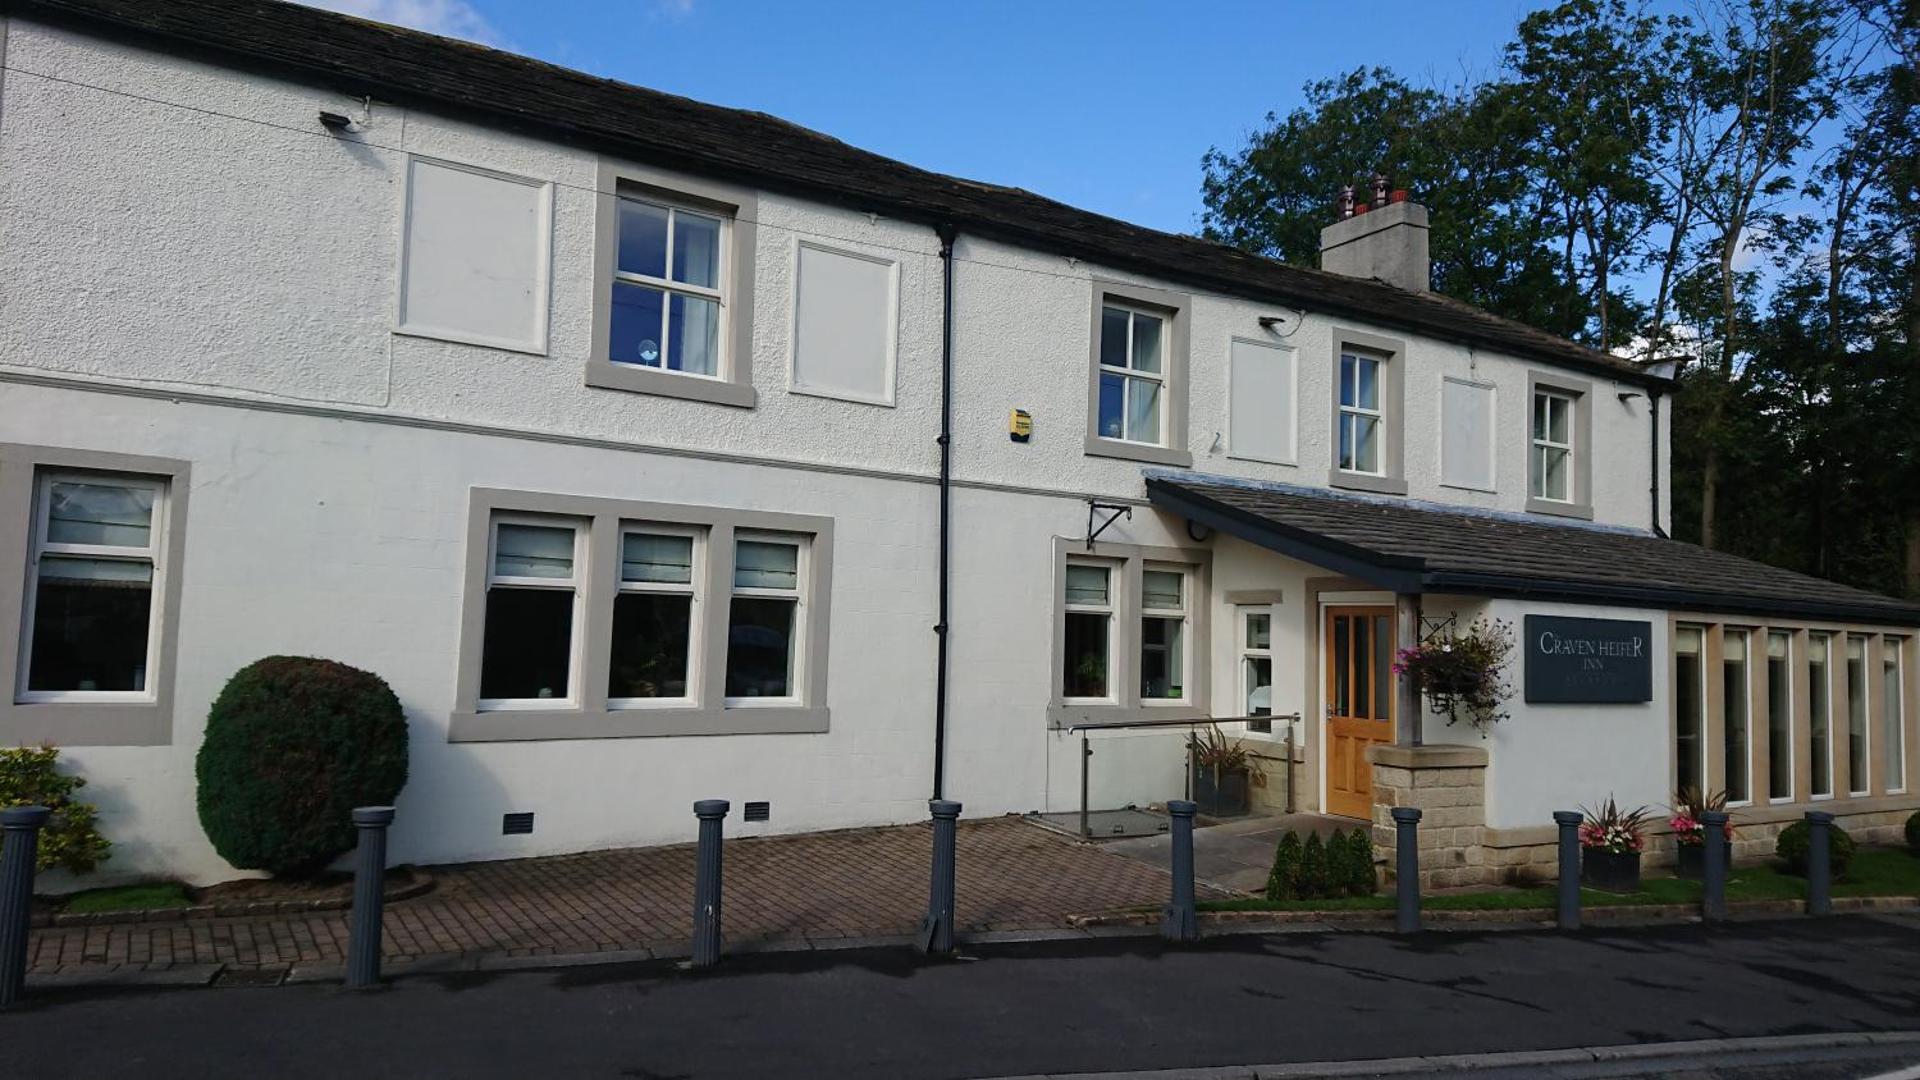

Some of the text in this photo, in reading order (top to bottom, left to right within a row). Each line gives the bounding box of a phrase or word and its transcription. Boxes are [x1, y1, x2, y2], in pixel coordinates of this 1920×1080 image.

[1540, 631, 1642, 657] CRAVEN HEIFER
[1583, 658, 1604, 670] INN
